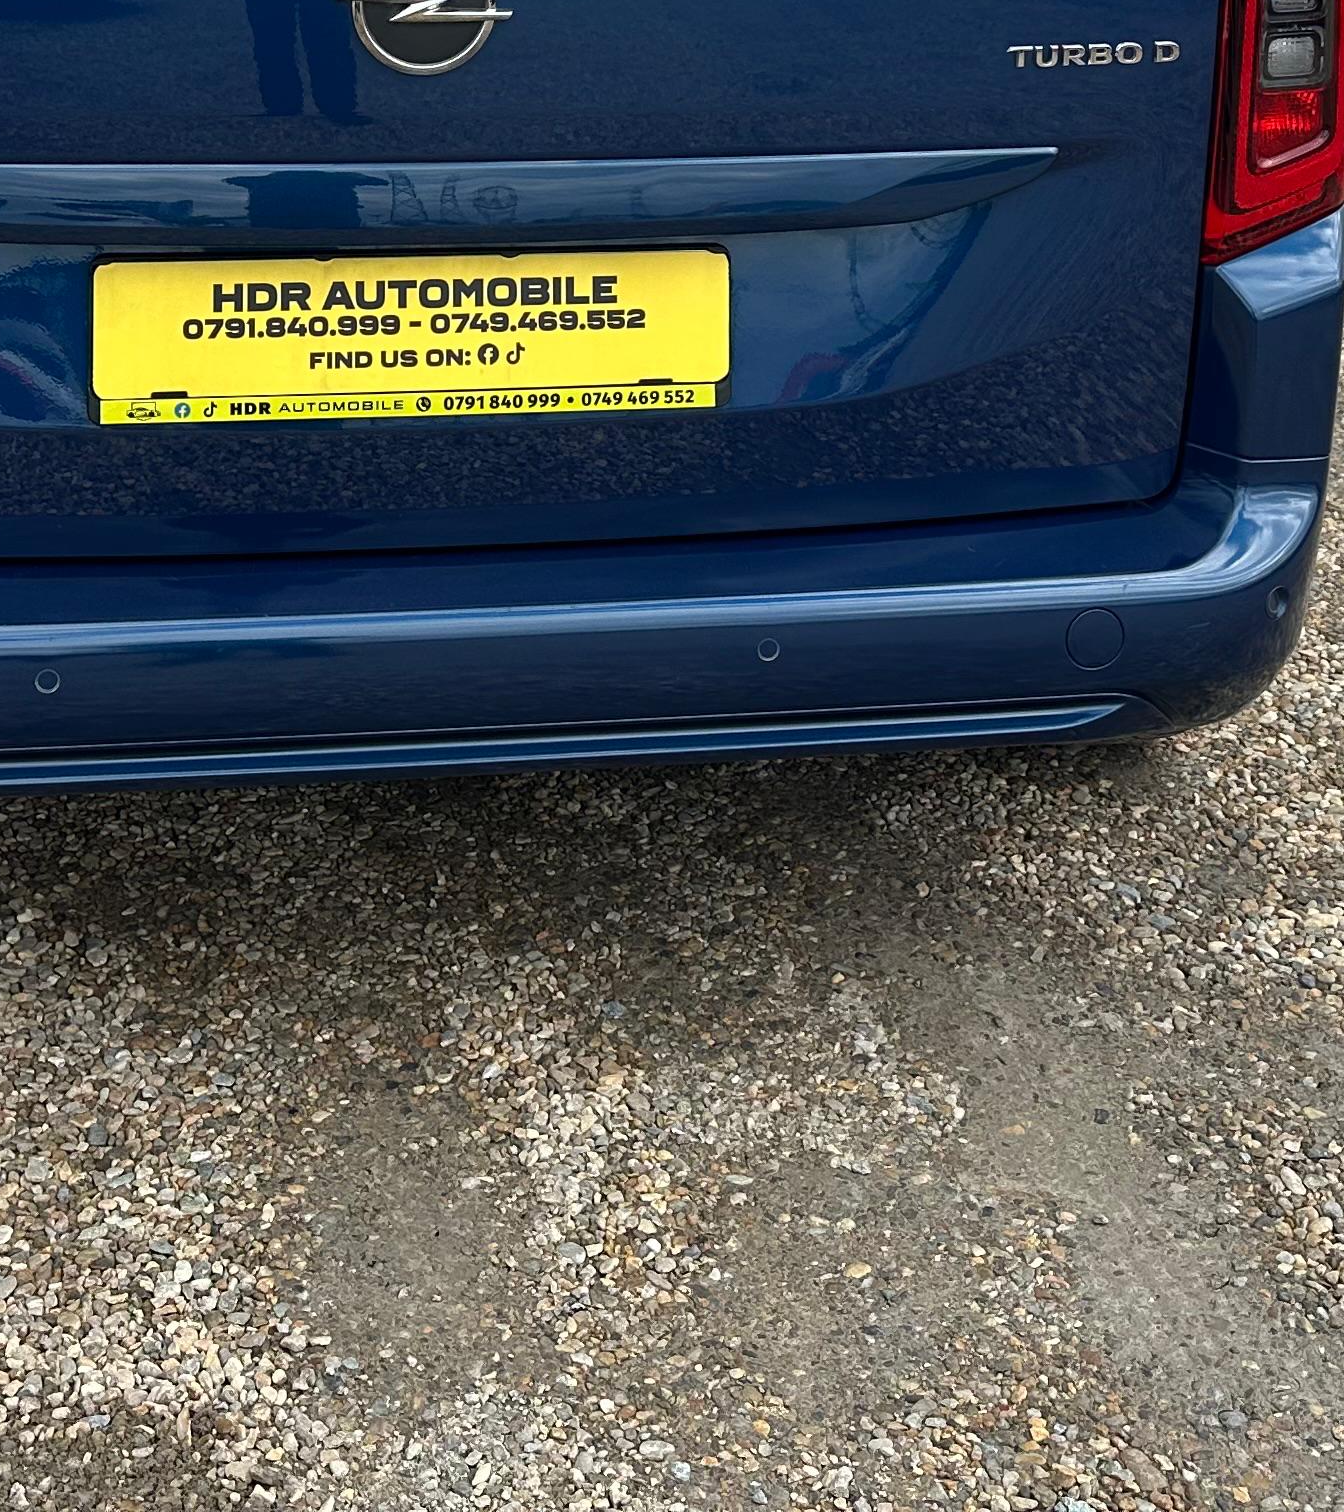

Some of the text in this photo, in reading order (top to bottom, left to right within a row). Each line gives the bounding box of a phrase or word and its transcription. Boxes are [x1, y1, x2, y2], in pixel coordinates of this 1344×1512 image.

[1006, 40, 1181, 68] TURBO D
[212, 275, 618, 313] HDR AUTOMOBILE
[183, 315, 401, 339] 0791.840.999
[430, 308, 646, 334] 0749.469.552
[309, 348, 471, 369] FIND US ON:
[230, 389, 695, 416] HDR AUTOMOBILE 0791 840 999 0749 469 552
